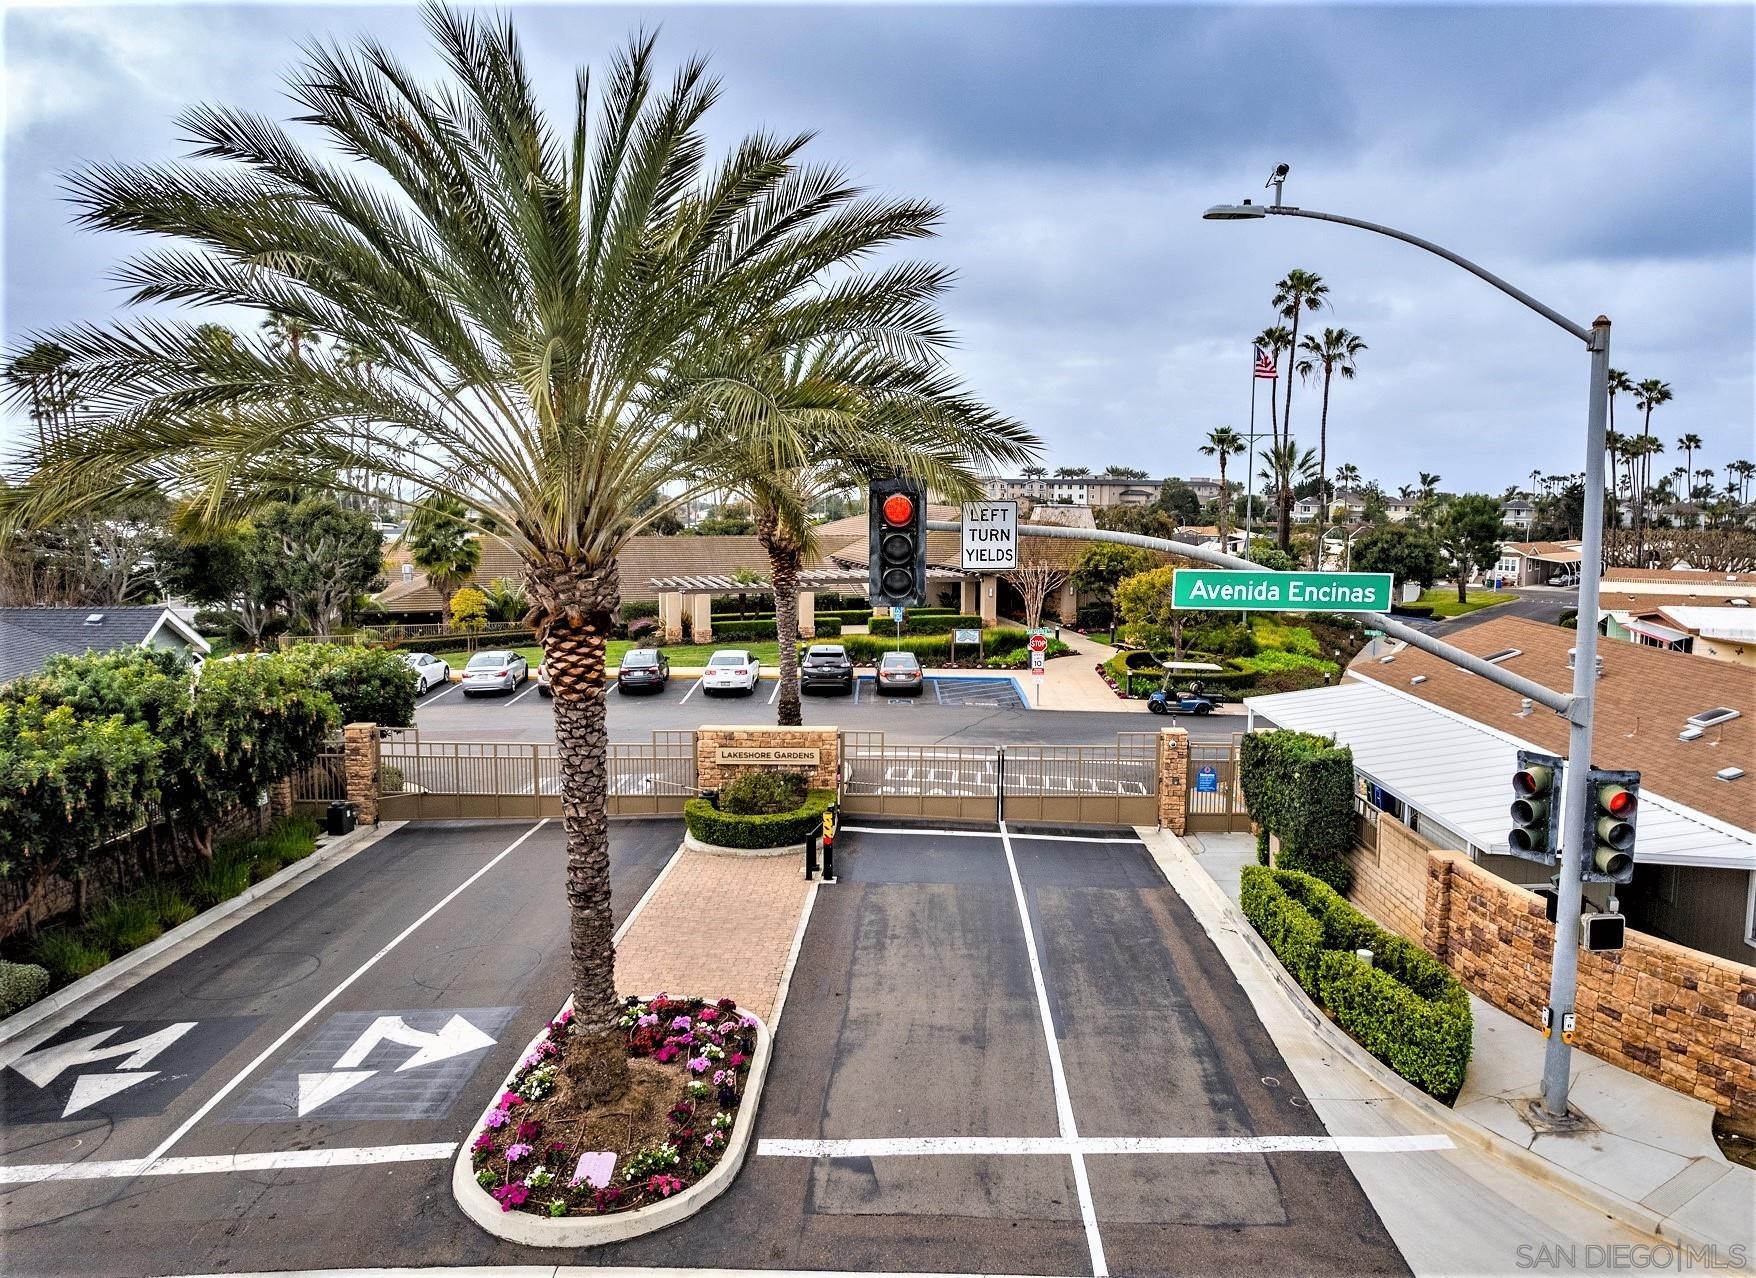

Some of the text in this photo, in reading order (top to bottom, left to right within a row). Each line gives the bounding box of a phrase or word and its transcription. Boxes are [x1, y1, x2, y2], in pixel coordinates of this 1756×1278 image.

[970, 508, 1009, 521] LEFT
[969, 529, 1010, 541] TURN
[966, 549, 1013, 561] YIELDS
[1188, 579, 1376, 603] Avenida Encinas
[721, 751, 815, 759] LAKESHORE GARDENS
